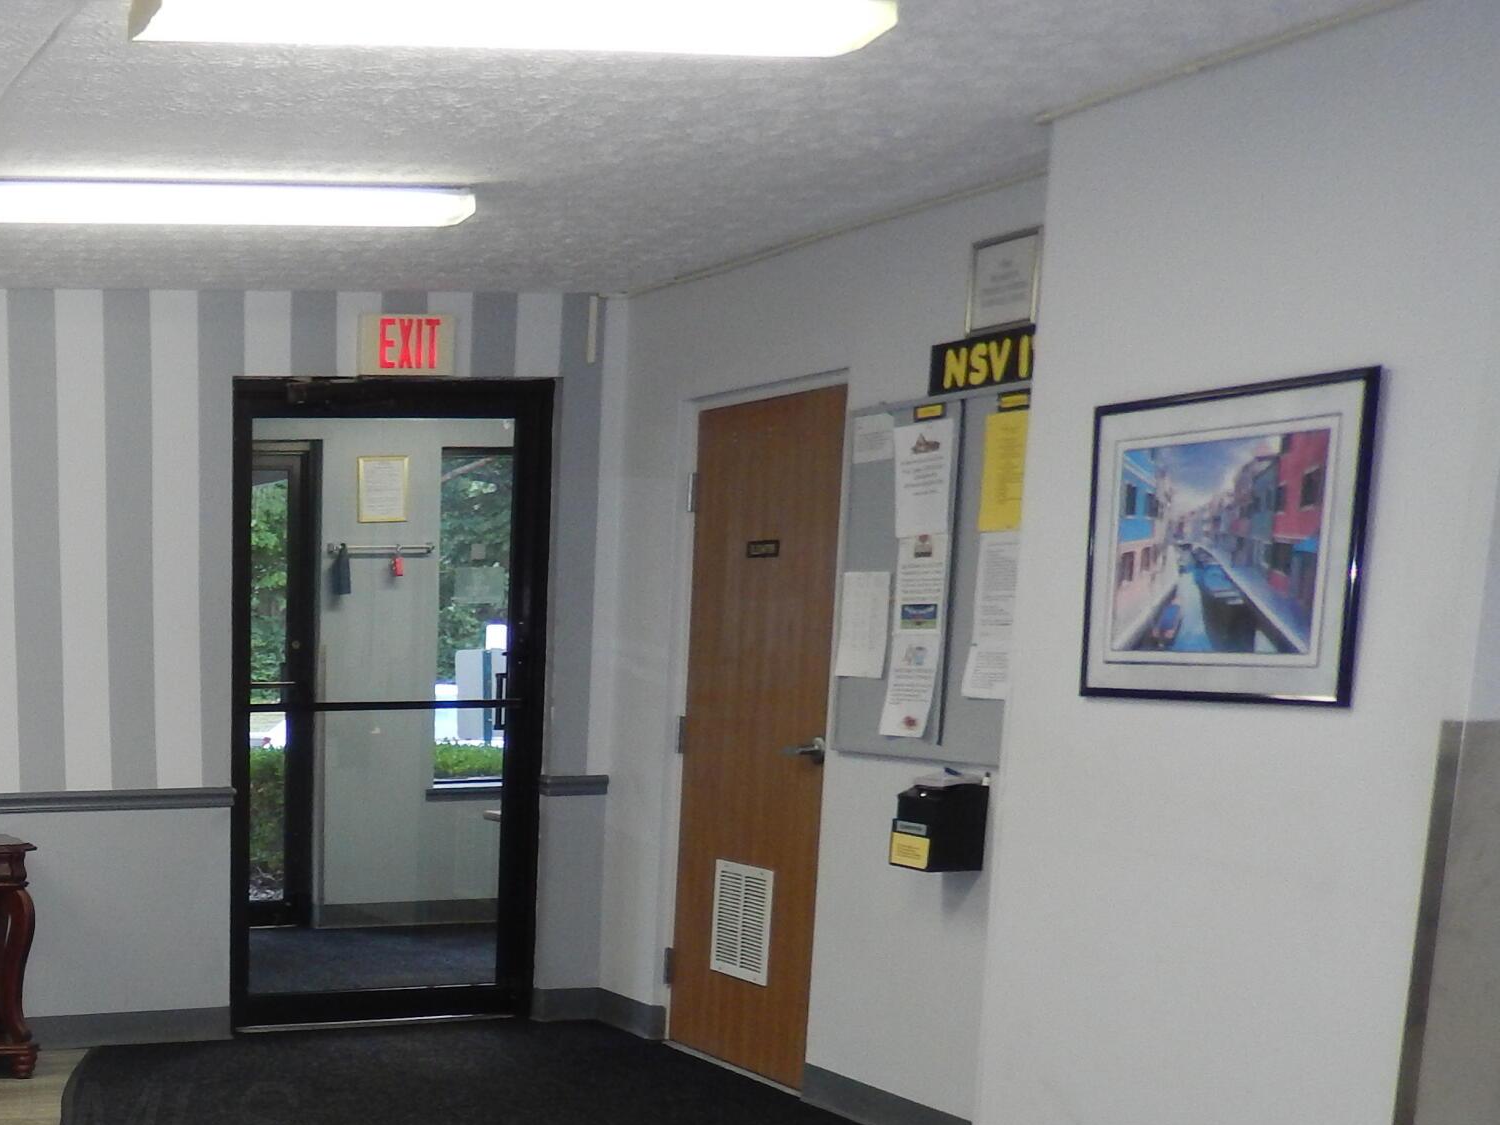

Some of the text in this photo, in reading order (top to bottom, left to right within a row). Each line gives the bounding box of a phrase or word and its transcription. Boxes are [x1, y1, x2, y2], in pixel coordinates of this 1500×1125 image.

[379, 318, 441, 369] EXIT
[943, 334, 1032, 389] NSV I
